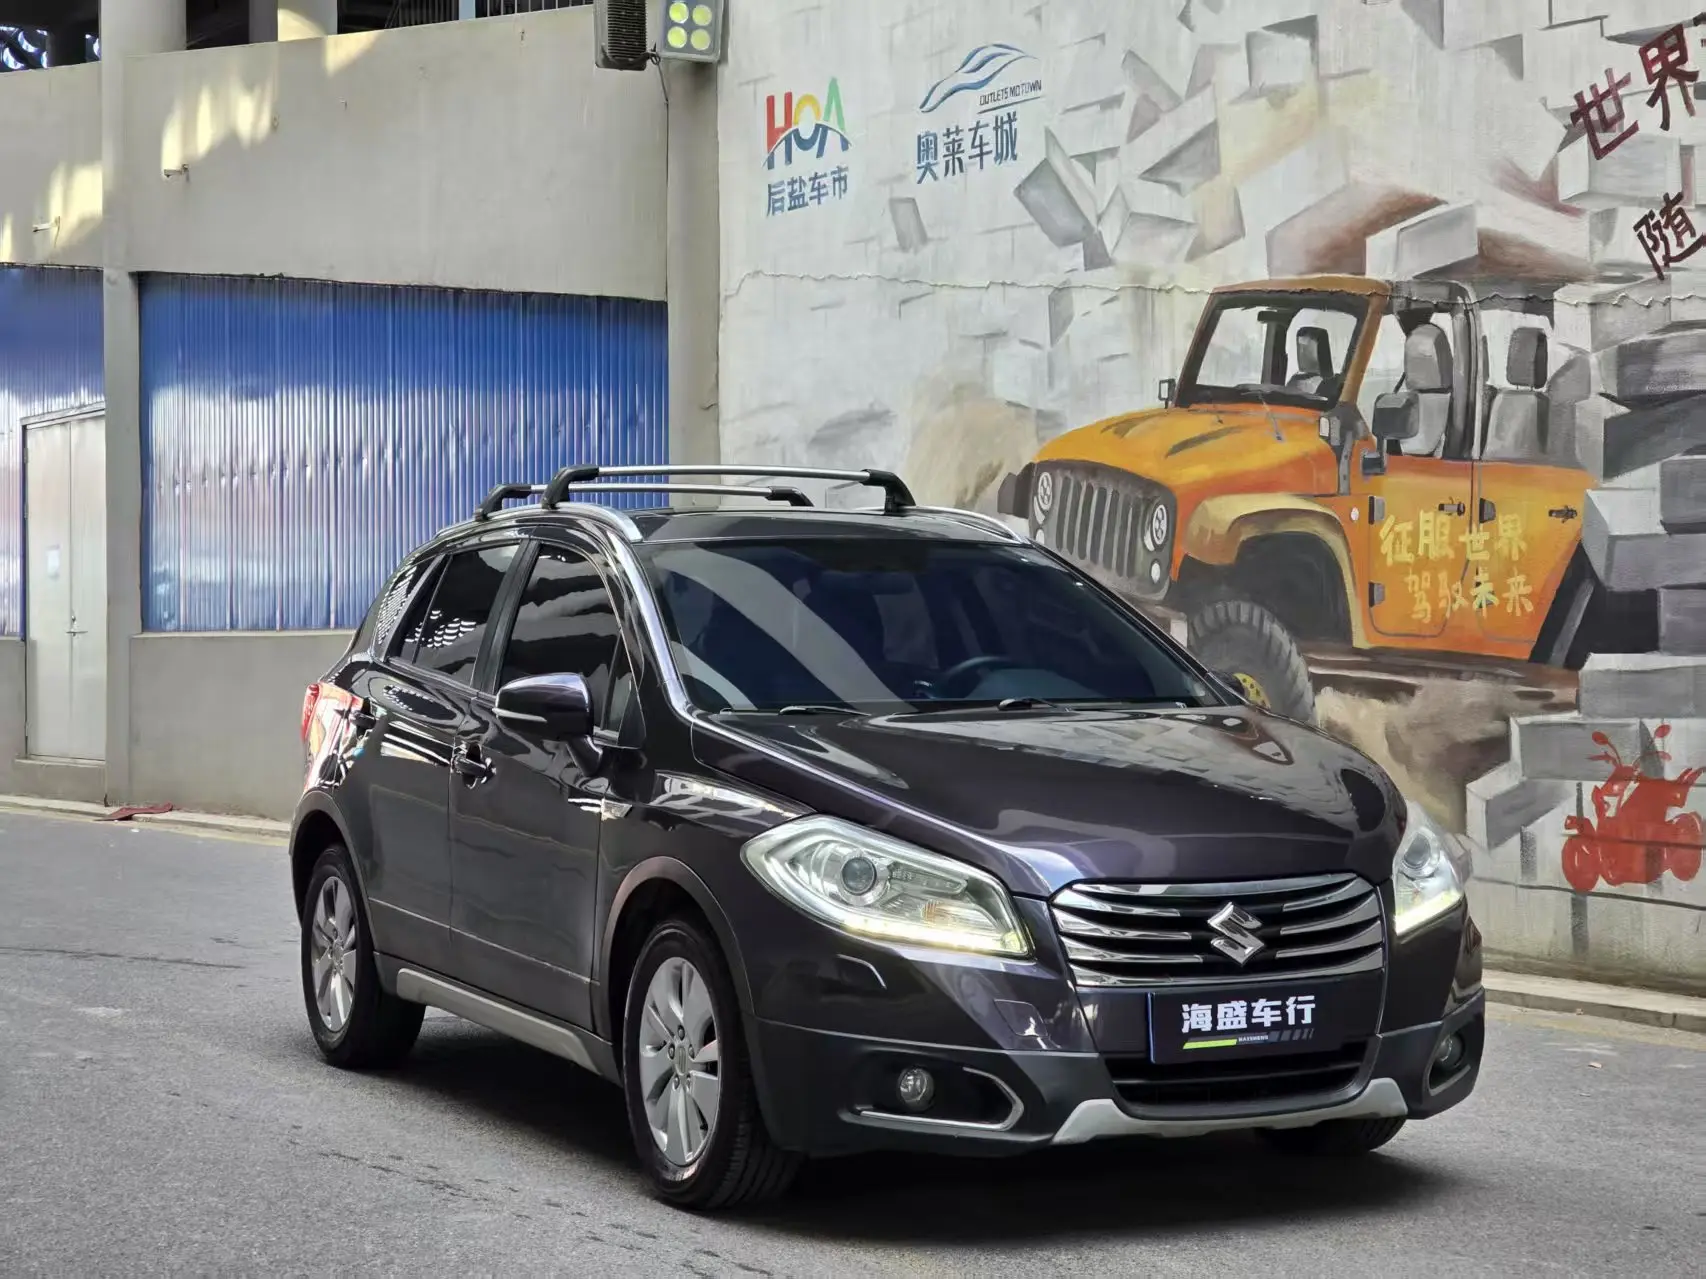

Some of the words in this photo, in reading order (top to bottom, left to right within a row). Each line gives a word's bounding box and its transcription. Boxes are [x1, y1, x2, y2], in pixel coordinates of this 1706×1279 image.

[979, 87, 1009, 105] OUTLETS
[1009, 80, 1042, 97] MOTOWN
[1570, 12, 1706, 160] 世界
[917, 111, 1018, 184] 奥莱车城
[766, 166, 849, 217] 后盐车市
[1379, 510, 1527, 567] 征服世界
[1404, 566, 1534, 624] 驾驭未来
[1181, 995, 1316, 1034] 海盛车行
